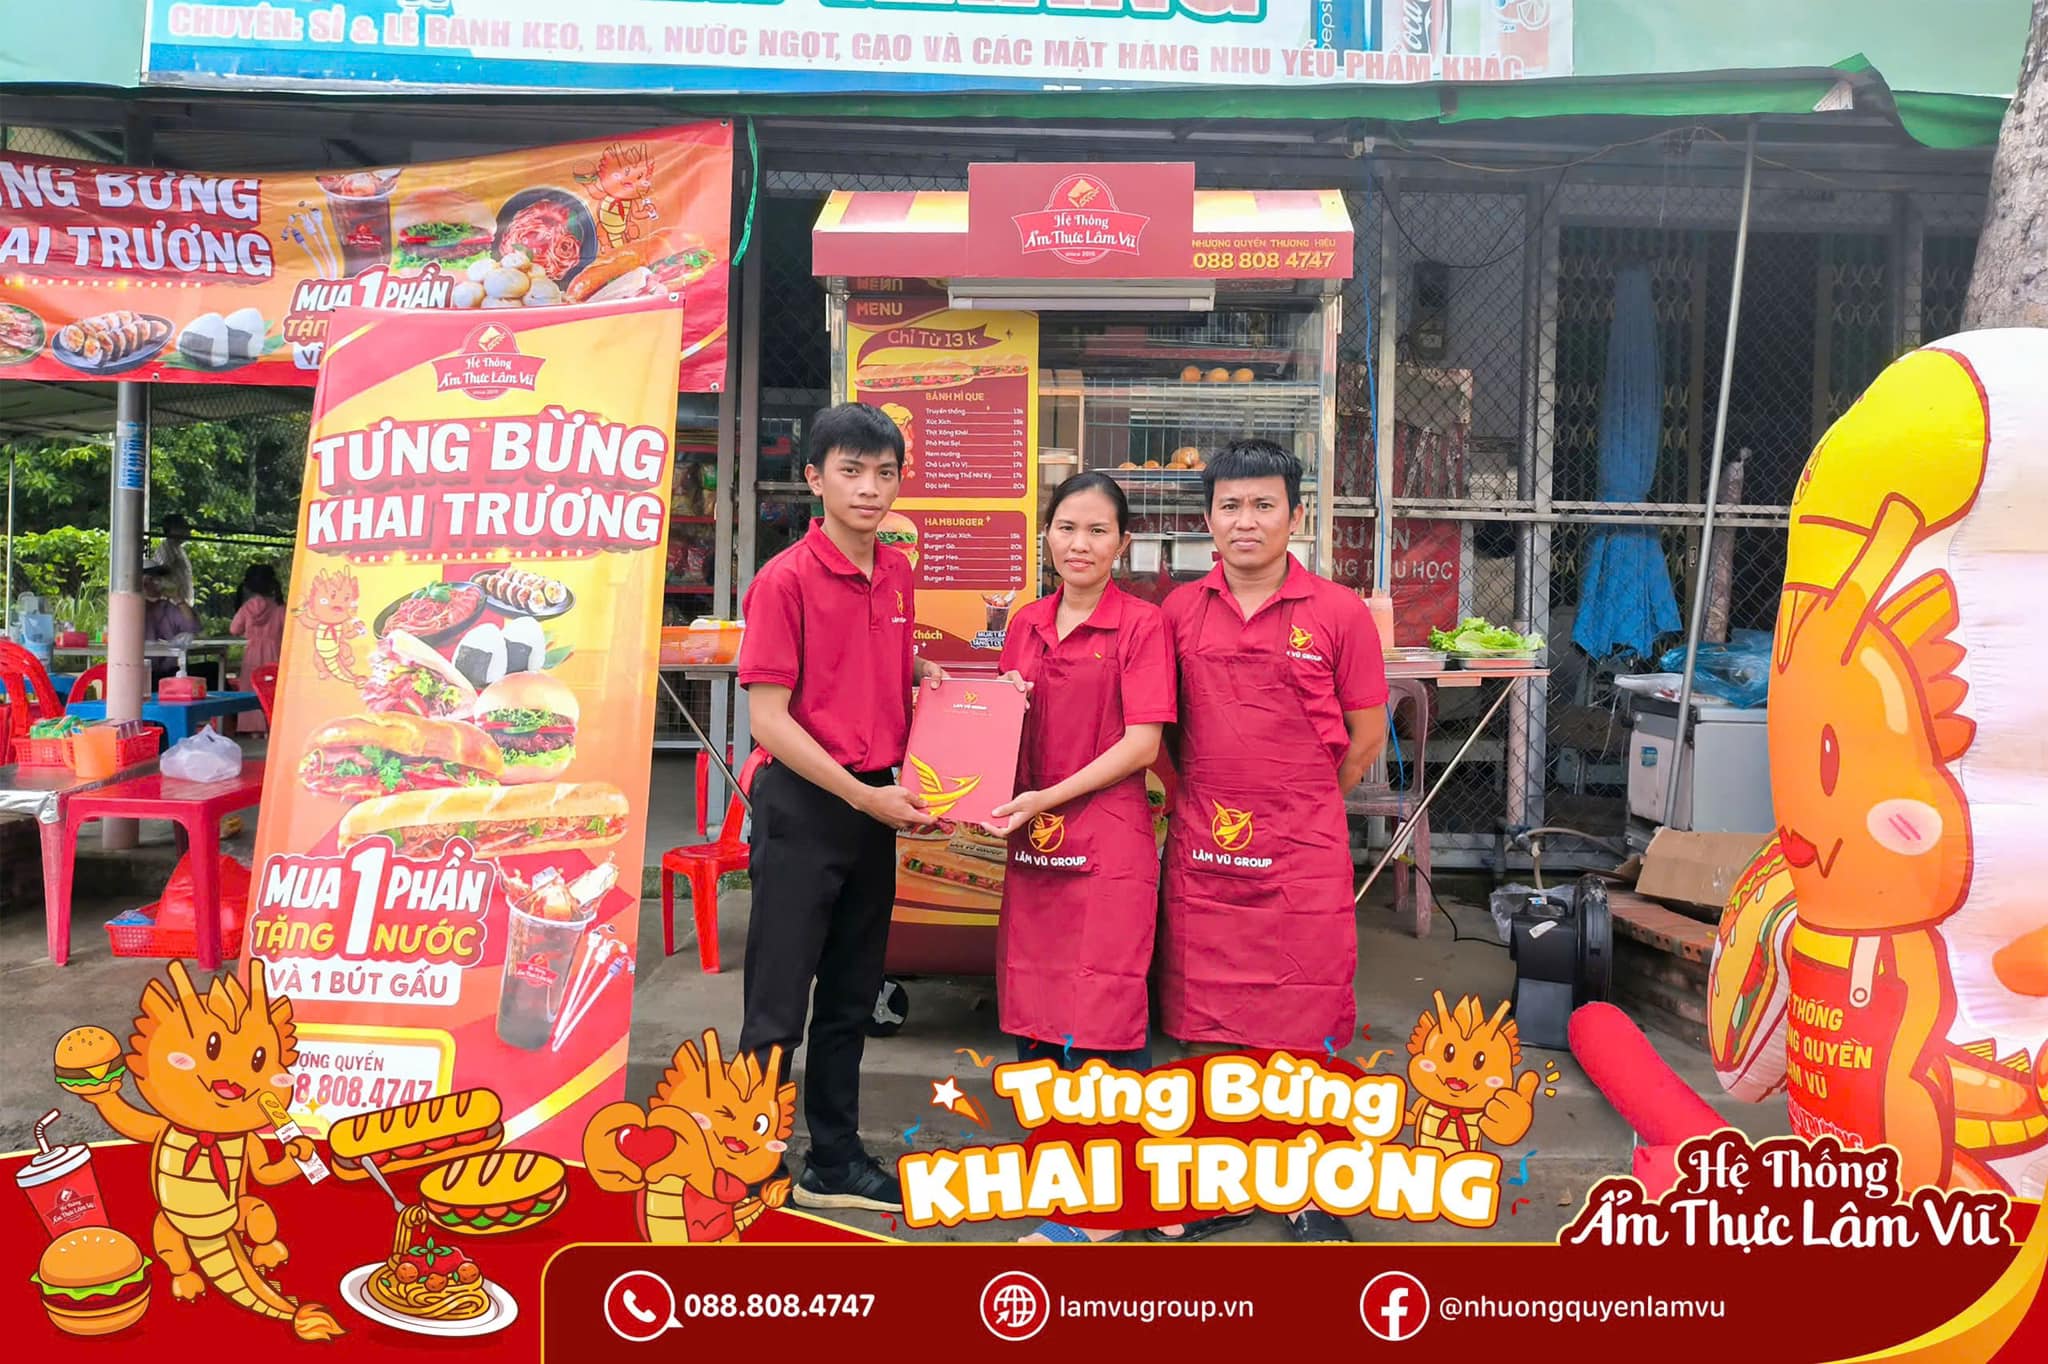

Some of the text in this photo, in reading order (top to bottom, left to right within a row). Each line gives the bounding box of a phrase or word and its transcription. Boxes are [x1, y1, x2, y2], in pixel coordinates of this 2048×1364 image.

[170, 4, 301, 38] CHUYÊN:
[352, 17, 376, 42] &
[522, 22, 584, 53] KẸO,
[596, 24, 653, 54] BIA,
[665, 23, 747, 55] NƯỚC
[759, 29, 840, 63] NGỌT,
[852, 33, 912, 65] GẠO
[923, 32, 962, 63] VÀ
[972, 34, 1032, 66] CÁC
[1044, 35, 1107, 72] MẶT
[1118, 40, 1199, 72] HÀNG
[1210, 47, 1271, 74] NHU
[1442, 54, 1523, 80] KHÁC
[66, 220, 272, 277] TRƯƠNG
[1086, 230, 1119, 246] Lâm
[1193, 252, 1336, 269] 088 808 4747
[296, 267, 448, 311] MUA 1 PHẦN
[856, 301, 903, 316] MENU
[888, 328, 915, 345] Chỉ
[921, 332, 942, 347] Từ
[945, 333, 964, 347] 13
[925, 391, 952, 401] BÁNH
[965, 392, 985, 402] QUE
[313, 408, 665, 488] TƯNG BỪNG
[307, 484, 662, 545] KHAI TRƯƠNG
[924, 517, 985, 527] HAMBURGER
[1413, 560, 1453, 583] HỌC
[1015, 851, 1087, 867] LÂM VŨ GROUP
[1193, 849, 1273, 868] LÂM VŨ GROUP
[264, 847, 487, 955] MUA 1 PHẦN
[374, 916, 477, 957] NƯỚC
[269, 962, 448, 998] VÀ 1 BÚT GẤU
[1792, 991, 1844, 1031] THỐNG
[1804, 1037, 1872, 1069] QUYỀN
[1805, 1070, 1828, 1099] VŨ
